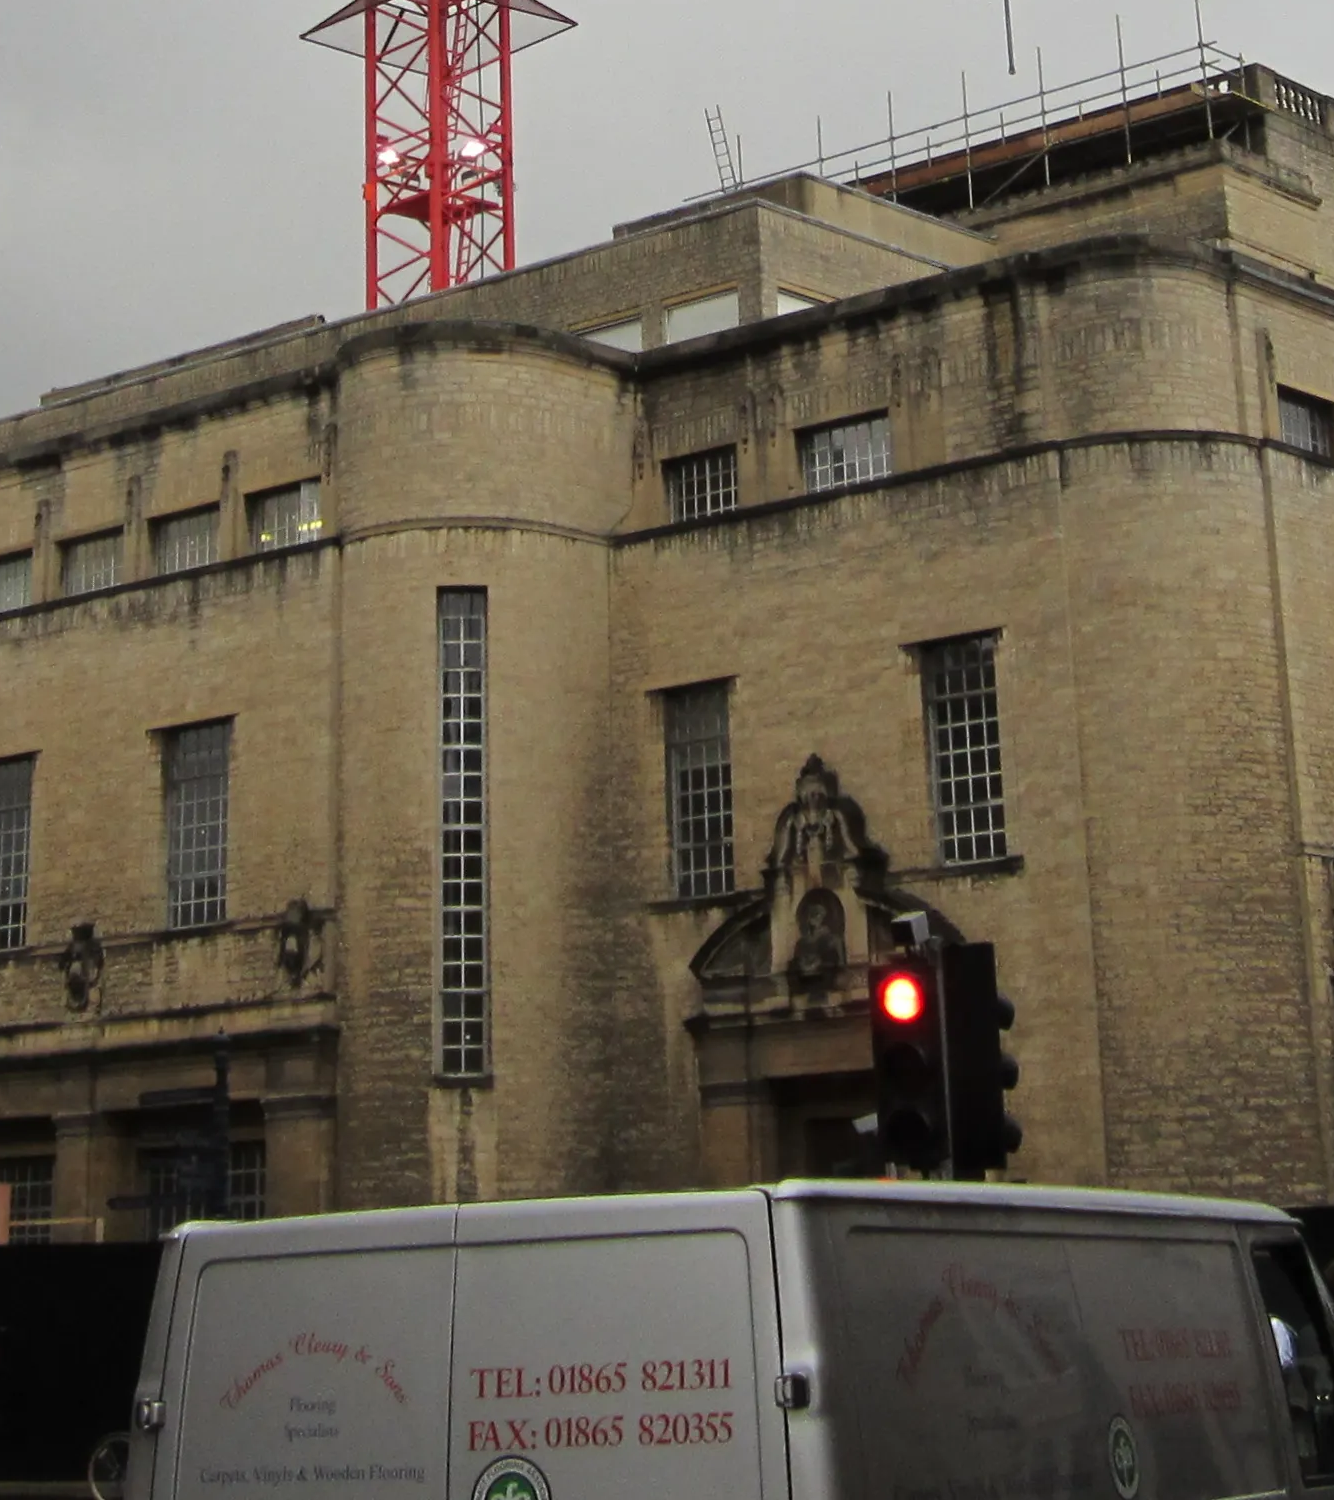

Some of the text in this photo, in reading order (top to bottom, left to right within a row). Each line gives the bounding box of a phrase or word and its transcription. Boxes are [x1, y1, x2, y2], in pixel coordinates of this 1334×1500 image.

[219, 1351, 284, 1410] Thomas
[375, 1358, 409, 1404] Sons
[470, 1358, 733, 1399] TEL: 01865 821311
[468, 1412, 733, 1451] FAX: 01865 820355
[296, 1467, 309, 1482] &
[313, 1465, 365, 1482] Wooden
[369, 1464, 425, 1485] Flooring
